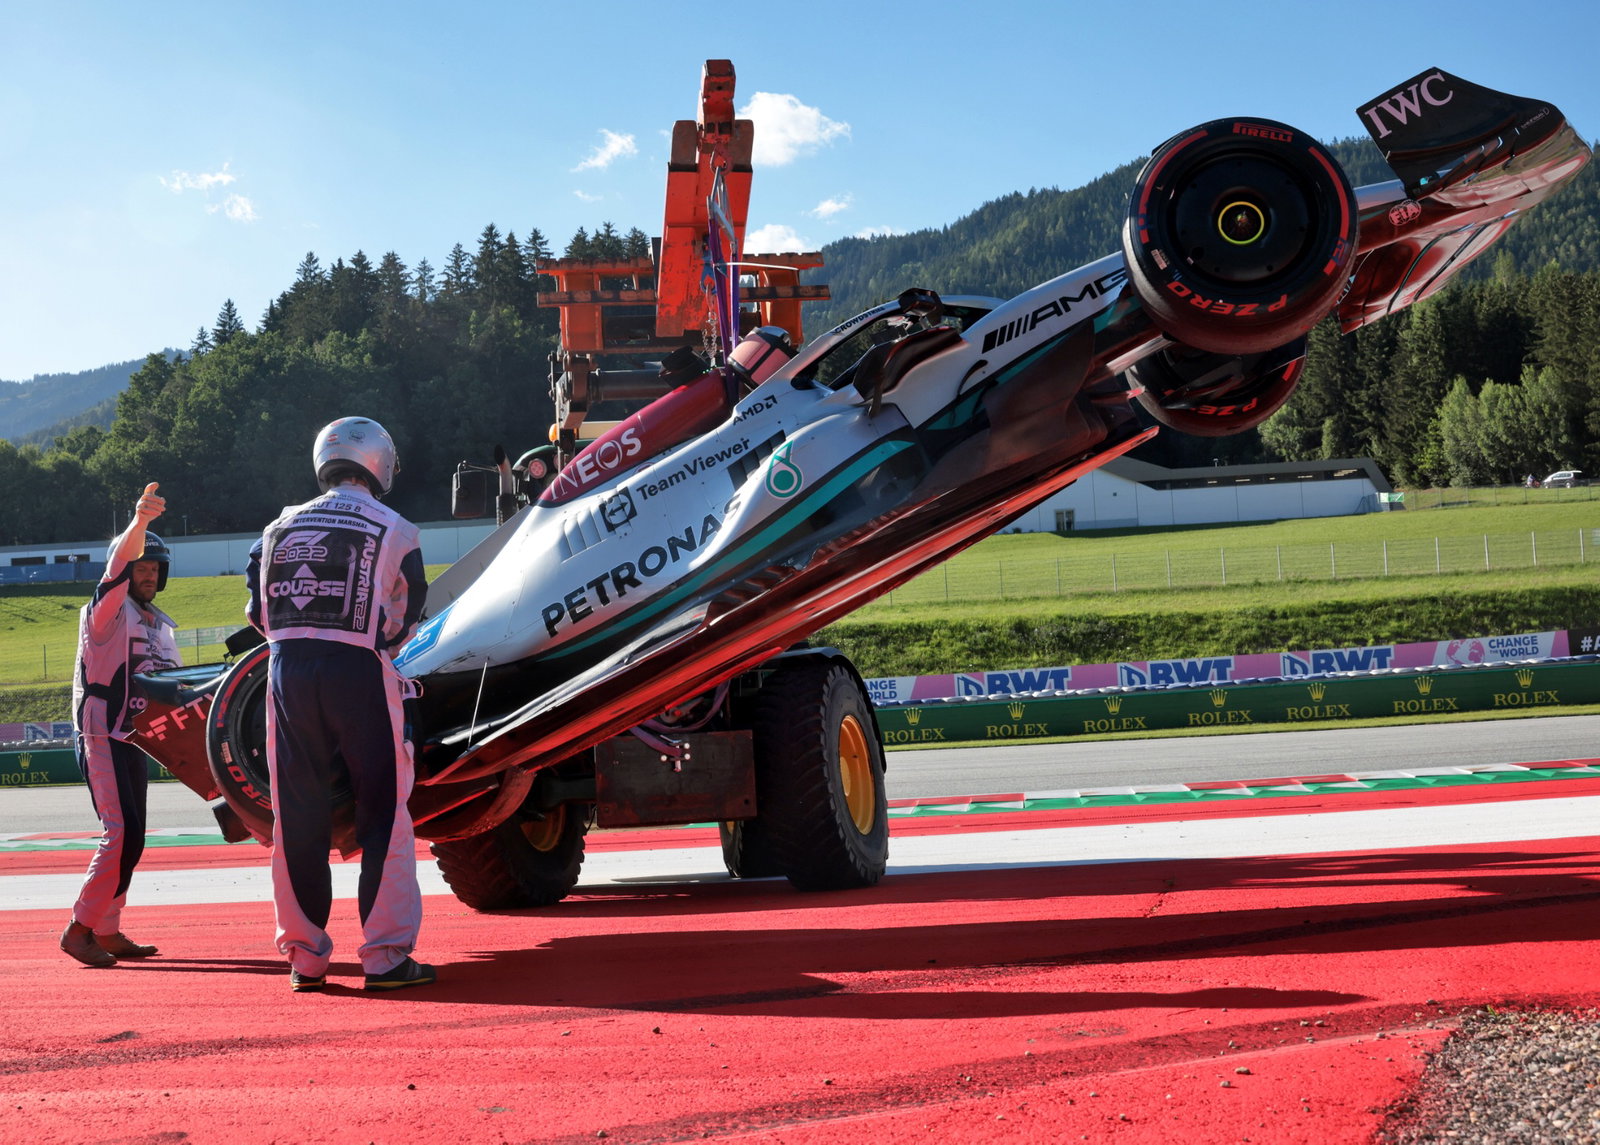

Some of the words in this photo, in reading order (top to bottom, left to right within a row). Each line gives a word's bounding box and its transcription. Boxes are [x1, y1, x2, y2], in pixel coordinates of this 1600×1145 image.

[1364, 72, 1453, 139] IWC
[1232, 122, 1294, 143] PIRELLI
[1389, 203, 1421, 225] FIA
[1029, 267, 1127, 332] AMG
[1166, 281, 1260, 316] ZERO
[834, 306, 885, 334] CROWDSTRIKE
[733, 402, 764, 426] AMD
[551, 427, 642, 501] INEOS
[636, 436, 750, 500] TeamViewer
[292, 517, 337, 525] INTERVENTION
[337, 519, 369, 529] MARSHAL
[273, 546, 328, 564] 2022
[268, 580, 346, 598] COURSE
[1488, 635, 1538, 649] CHANGE
[1311, 647, 1392, 673] BWT
[1499, 646, 1539, 658] WORLD
[1149, 658, 1232, 684] BWT
[986, 669, 1069, 696] BWT
[1393, 697, 1459, 713] ROLEX
[1493, 690, 1560, 706] ROLEX
[1187, 710, 1253, 725] ROLEX
[1286, 704, 1351, 720] ROLEX
[985, 723, 1049, 738] ROLEX
[1083, 716, 1147, 733] ROLEX
[883, 728, 945, 743] ROLEX
[1, 771, 49, 784] ROLEX
